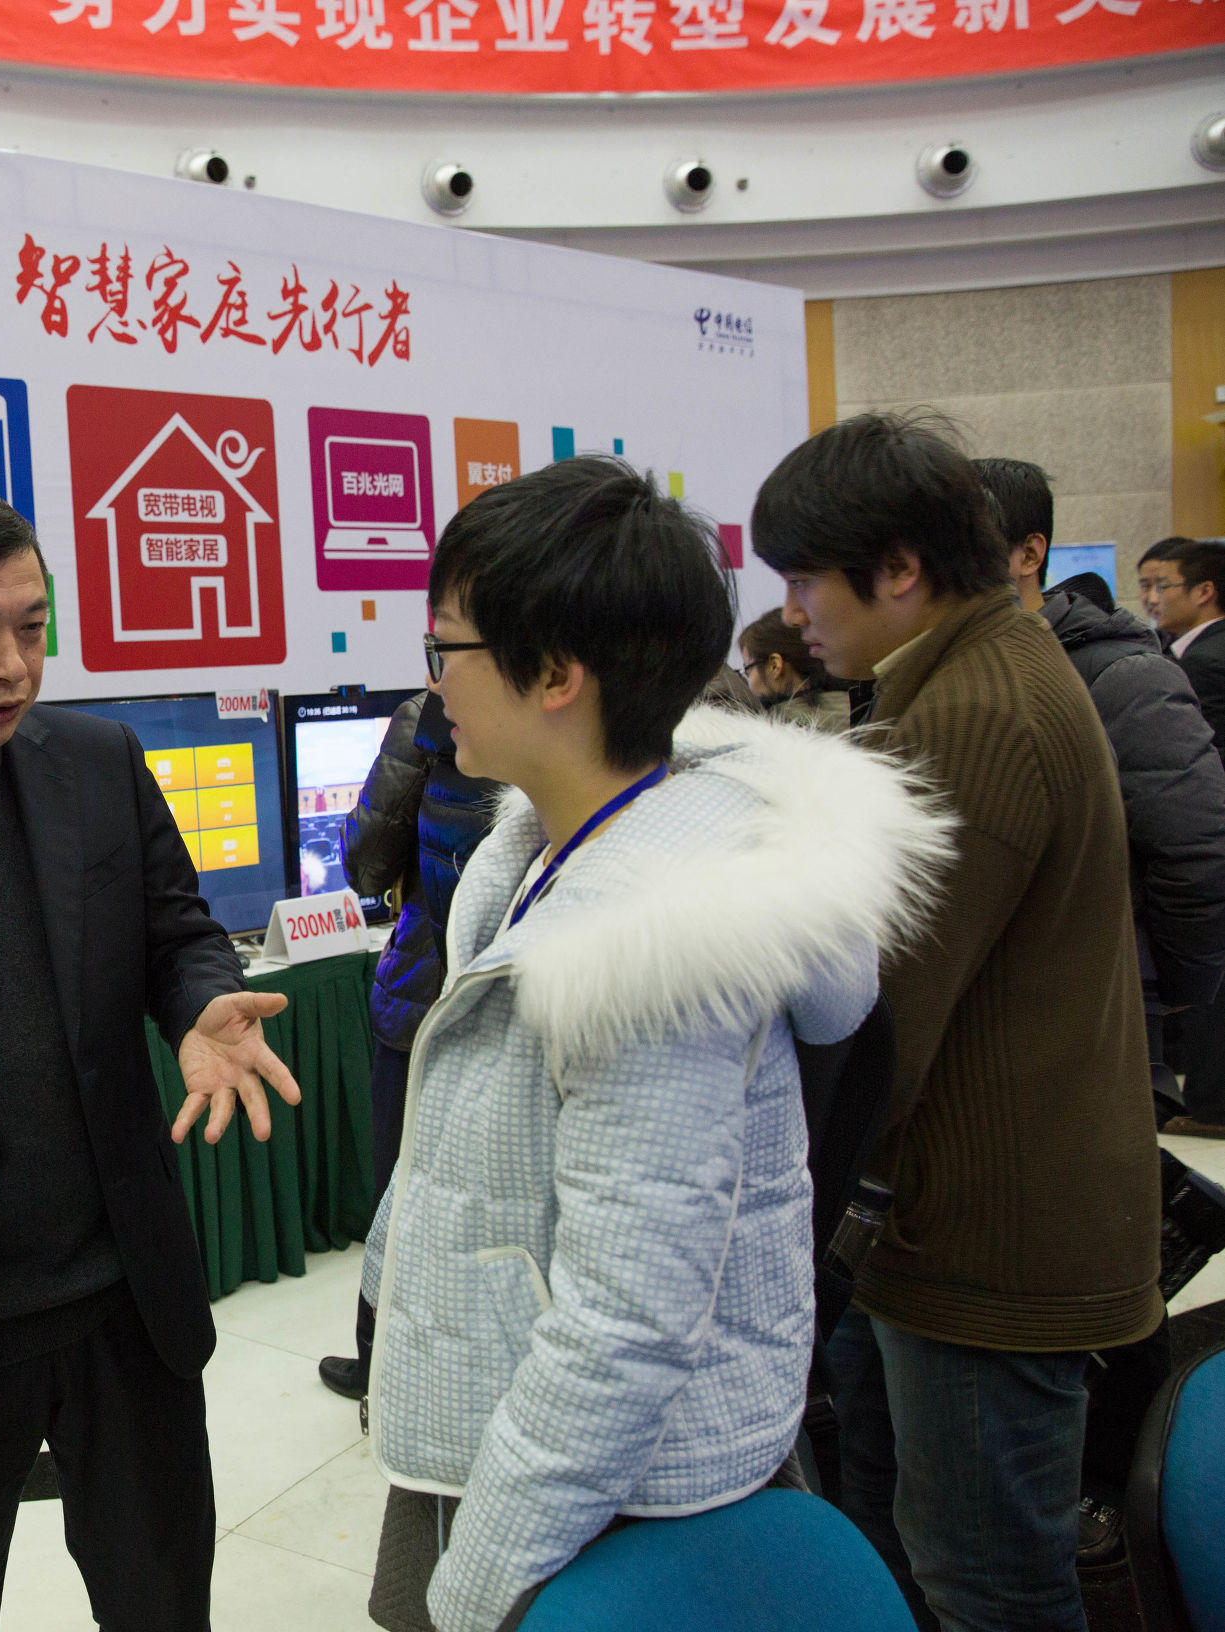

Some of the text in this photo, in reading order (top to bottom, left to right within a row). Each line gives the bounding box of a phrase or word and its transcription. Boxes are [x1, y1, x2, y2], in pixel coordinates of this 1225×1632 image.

[16, 233, 412, 367] 智慧家庭先行者
[341, 471, 404, 497] 百兆光网
[467, 462, 512, 486] 翼支付
[142, 493, 218, 518] 宽带电视
[146, 537, 220, 562] 智能家居
[218, 696, 251, 712] 200M
[287, 911, 337, 941] 200M
